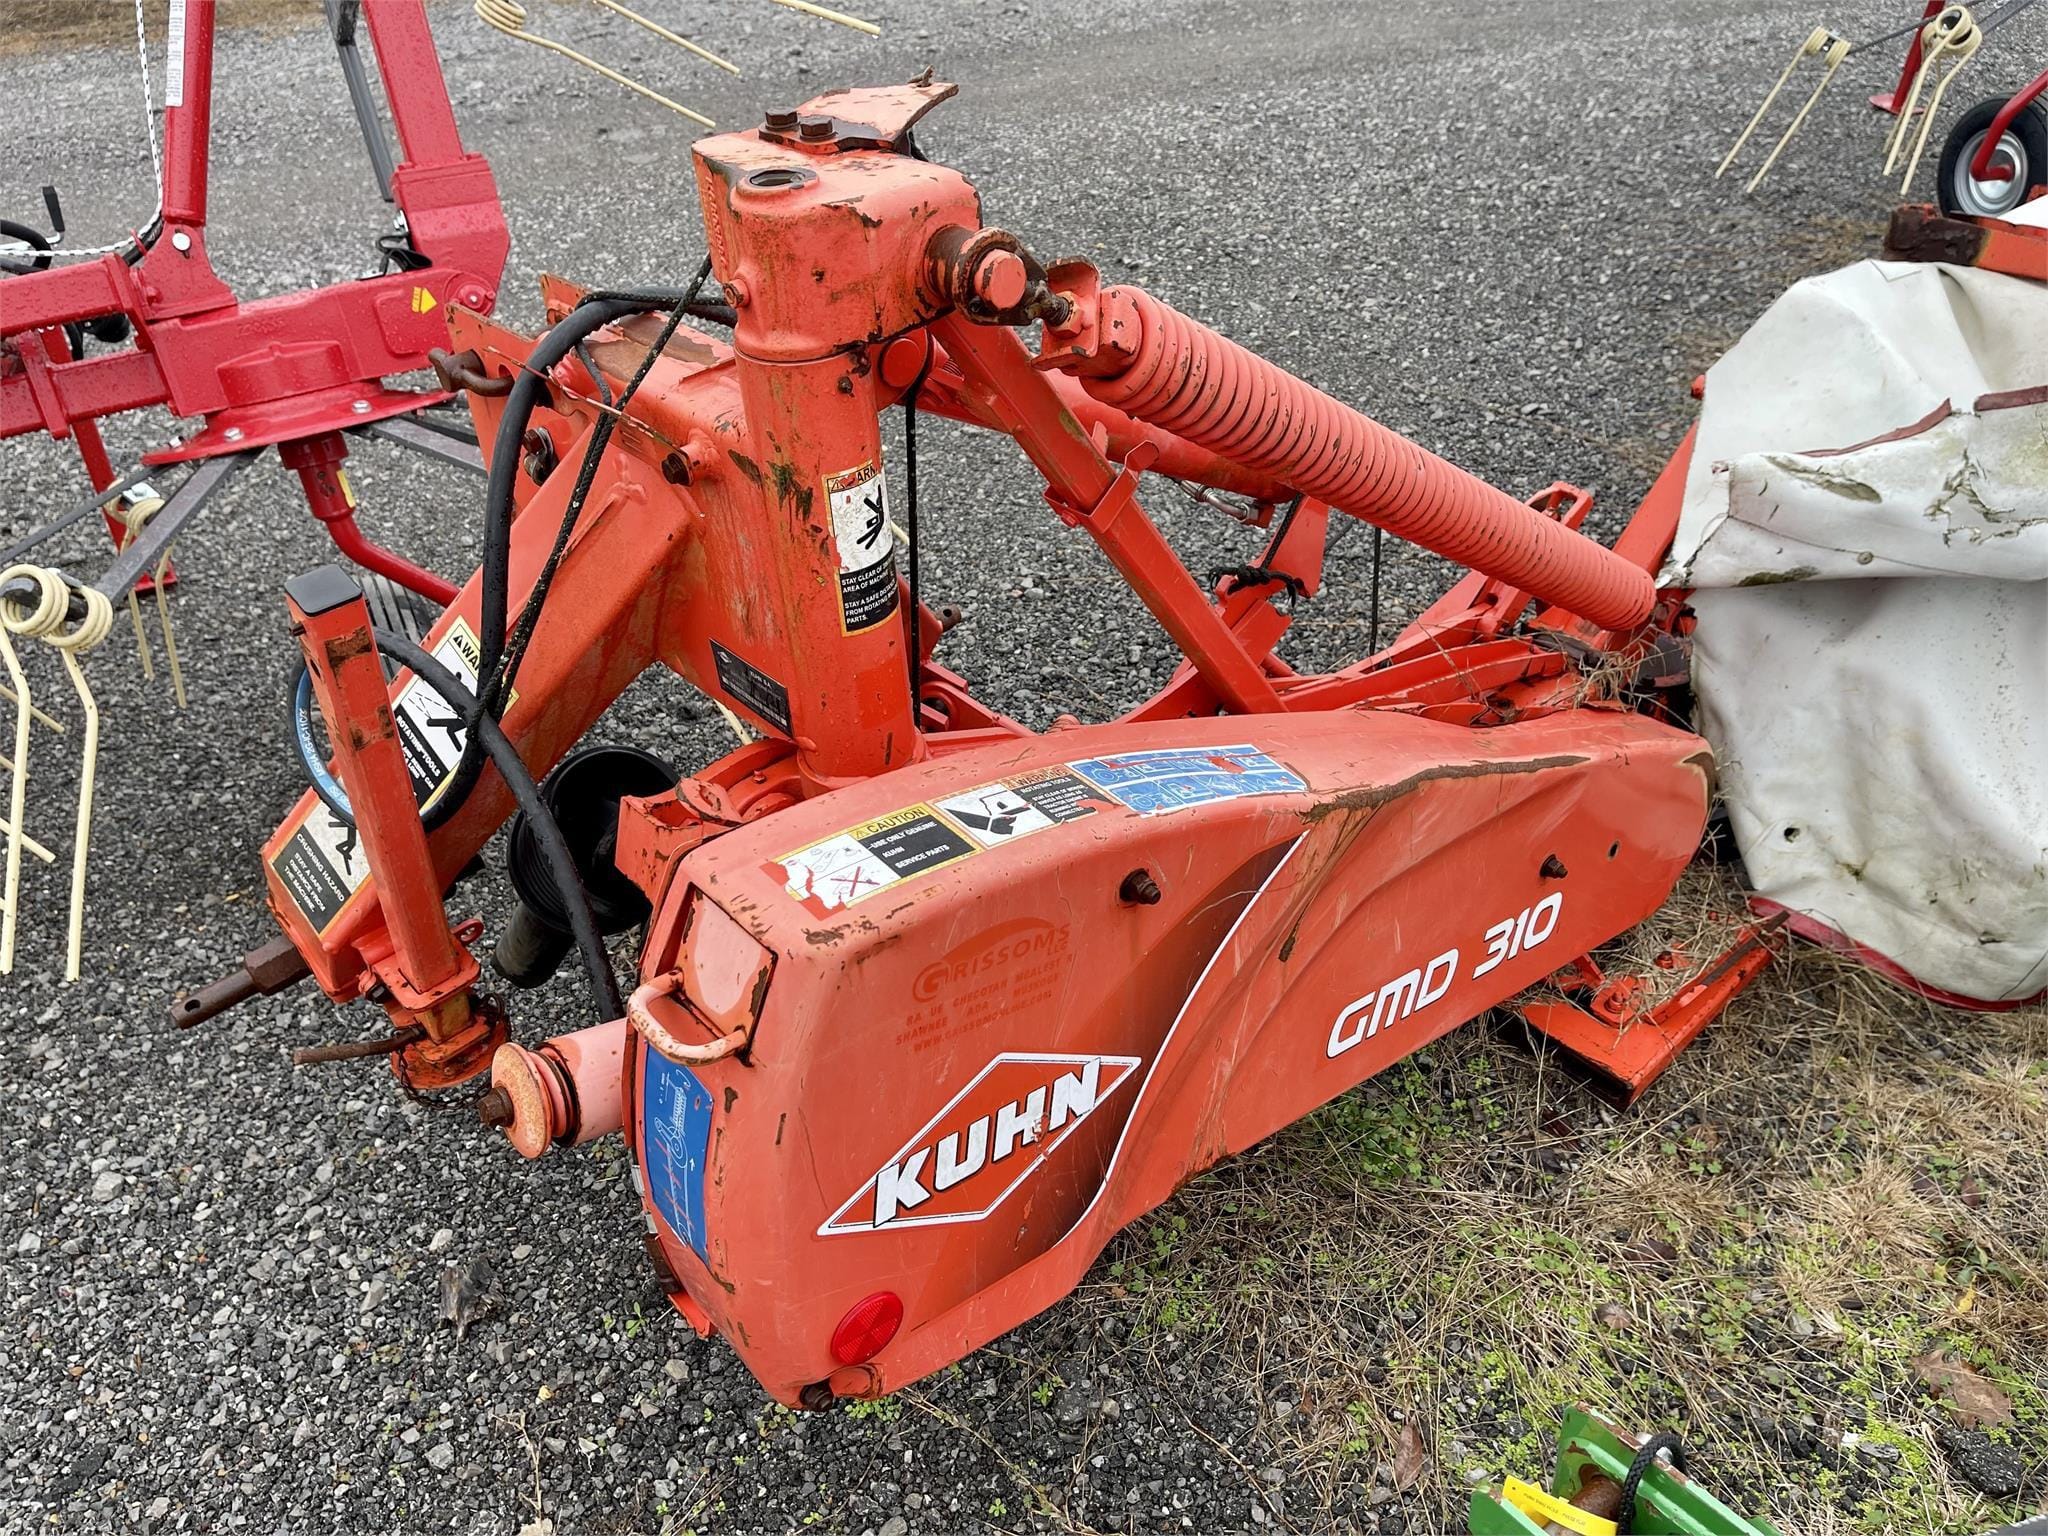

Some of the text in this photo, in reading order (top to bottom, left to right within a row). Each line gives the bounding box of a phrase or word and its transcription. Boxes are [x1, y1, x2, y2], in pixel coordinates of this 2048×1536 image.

[842, 577, 857, 586] STAY
[858, 569, 876, 582] CLEAR
[843, 584, 860, 594] AREA
[860, 581, 868, 589] OF
[845, 601, 859, 609] STAY
[866, 592, 880, 603] SAFE
[846, 607, 863, 616] FROM
[864, 595, 888, 612] ROTATING
[396, 715, 440, 777] ROTATING TOOLS
[310, 754, 326, 777] MSHA
[1018, 768, 1068, 786] WARNING
[1020, 782, 1052, 793] ROTATING
[867, 808, 925, 833] CAUTION
[870, 821, 937, 848] USE ONLY GENUINE
[882, 846, 905, 858] KUHN
[895, 844, 950, 868] SERVICE PARTS
[295, 852, 308, 869] STAY
[309, 874, 323, 893] SAFE
[297, 833, 345, 902] CRUSHING HAZARD
[284, 865, 315, 912] THE MACHINE.
[289, 859, 326, 912] DISTANCE FROM
[1326, 891, 1563, 1058] GMD 310
[895, 1016, 948, 1046] SHAWNEE
[873, 1057, 1101, 1228] KUHN
